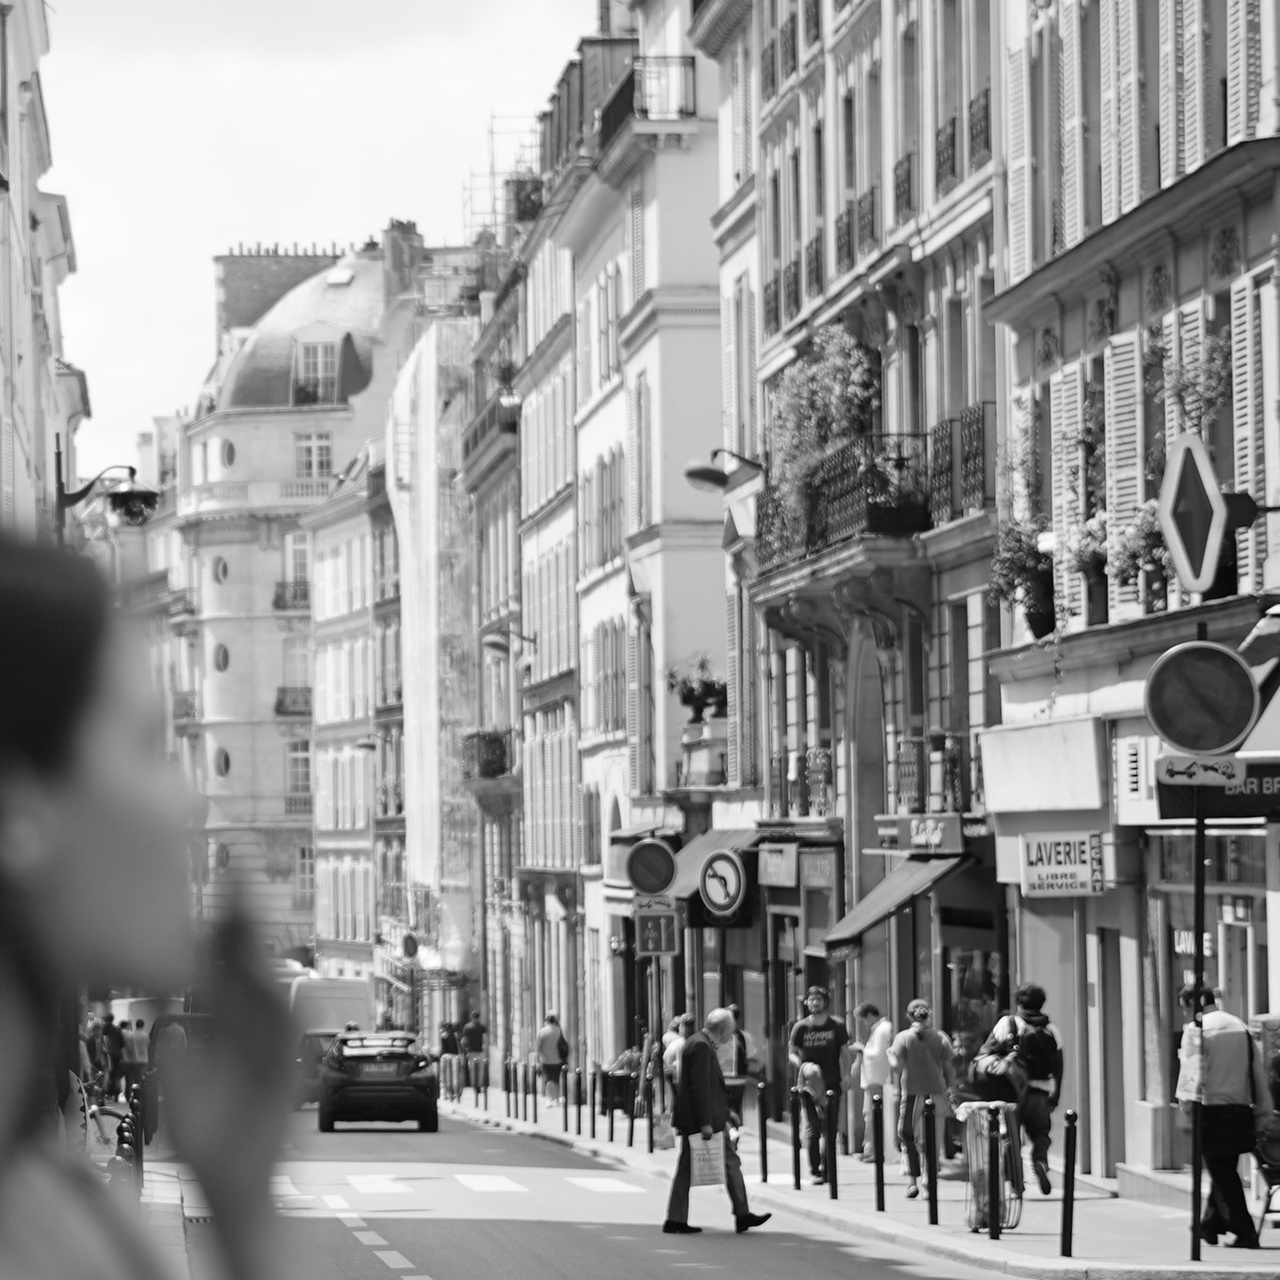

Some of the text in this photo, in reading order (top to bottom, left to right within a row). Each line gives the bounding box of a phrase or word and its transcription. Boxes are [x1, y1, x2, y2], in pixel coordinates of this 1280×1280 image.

[1026, 841, 1088, 867] LAVERIE
[1037, 872, 1078, 881] LIBRE
[1028, 881, 1088, 891] SERVICE
[803, 1030, 834, 1040] HOMME
